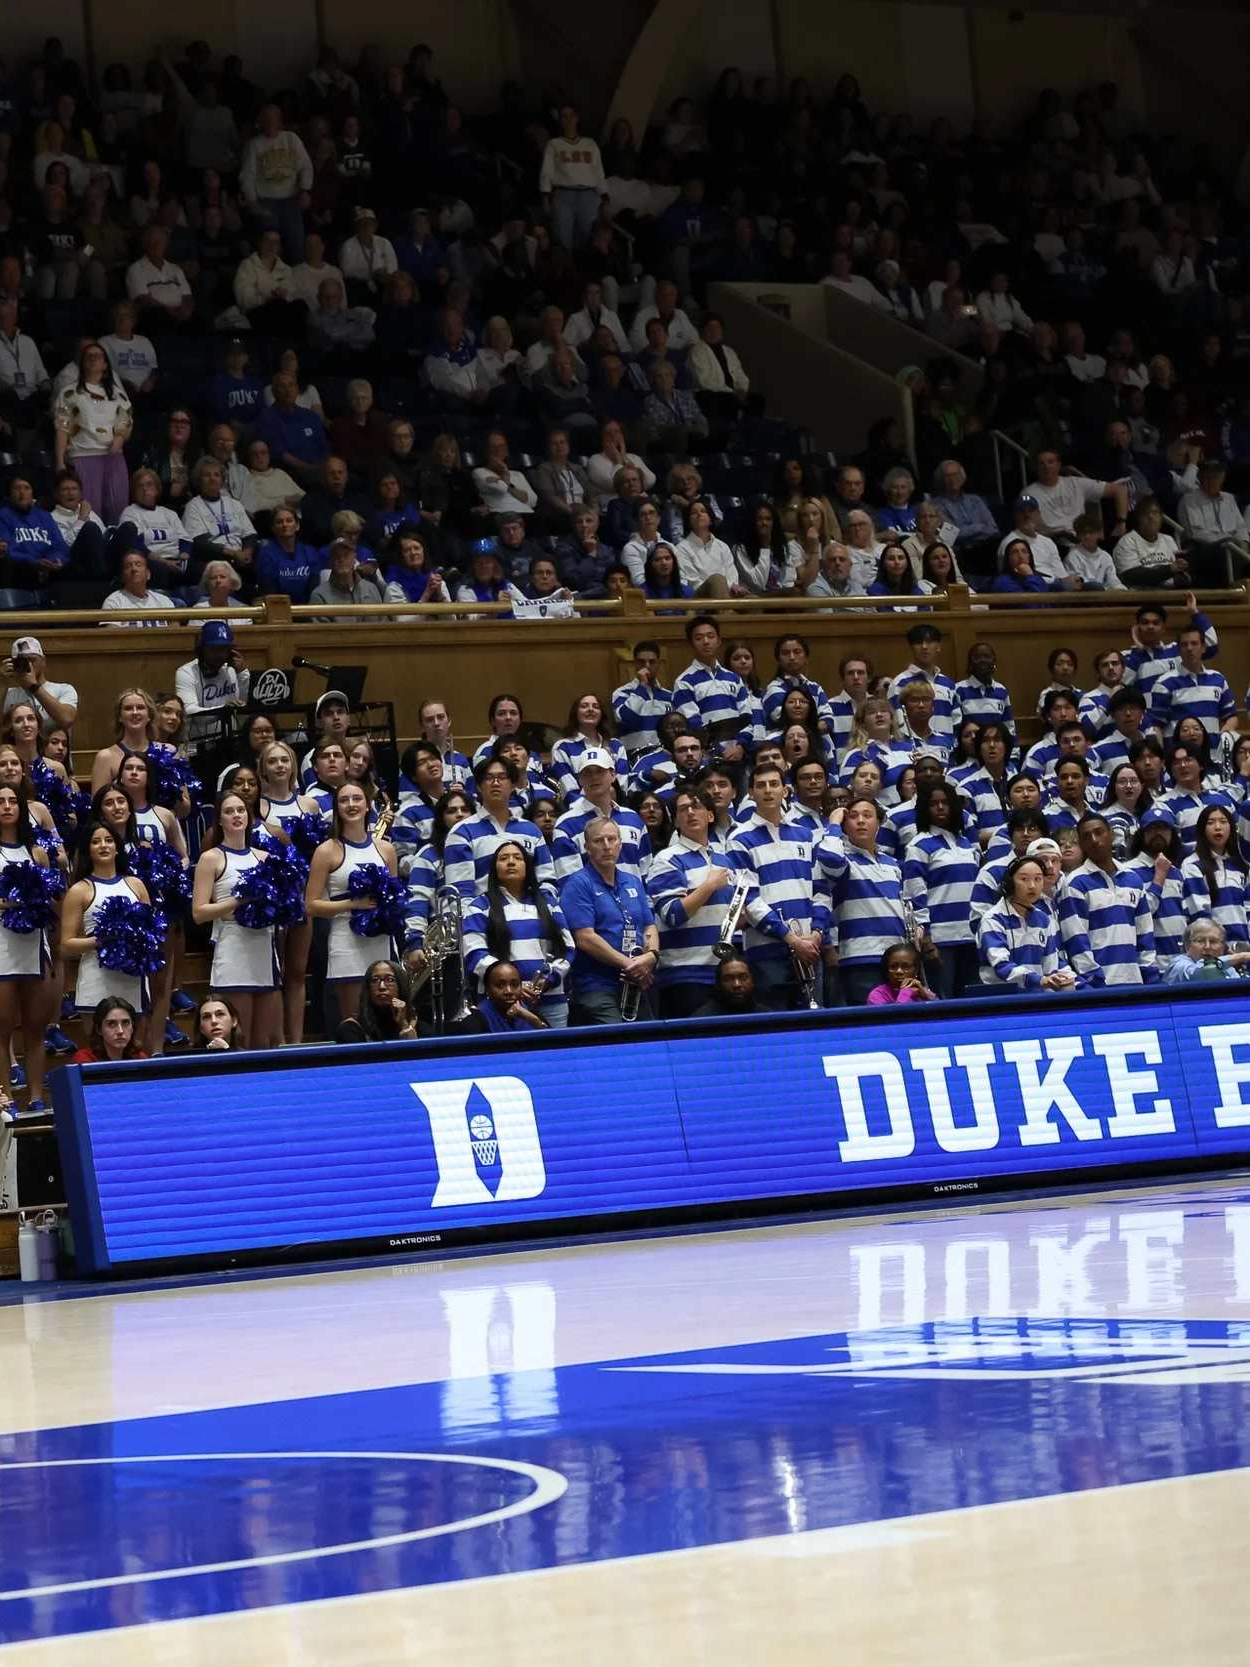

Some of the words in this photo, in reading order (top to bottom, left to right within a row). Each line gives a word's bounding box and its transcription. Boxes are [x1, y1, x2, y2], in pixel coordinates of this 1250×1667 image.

[15, 527, 52, 546] DUKE
[265, 673, 280, 684] DJ
[204, 681, 237, 702] Duke
[587, 751, 598, 760] D
[822, 1030, 1177, 1163] DUKE
[409, 1076, 547, 1208] D
[934, 1182, 979, 1193] DAKTRONICS
[390, 1234, 441, 1246] DAKTRONICS
